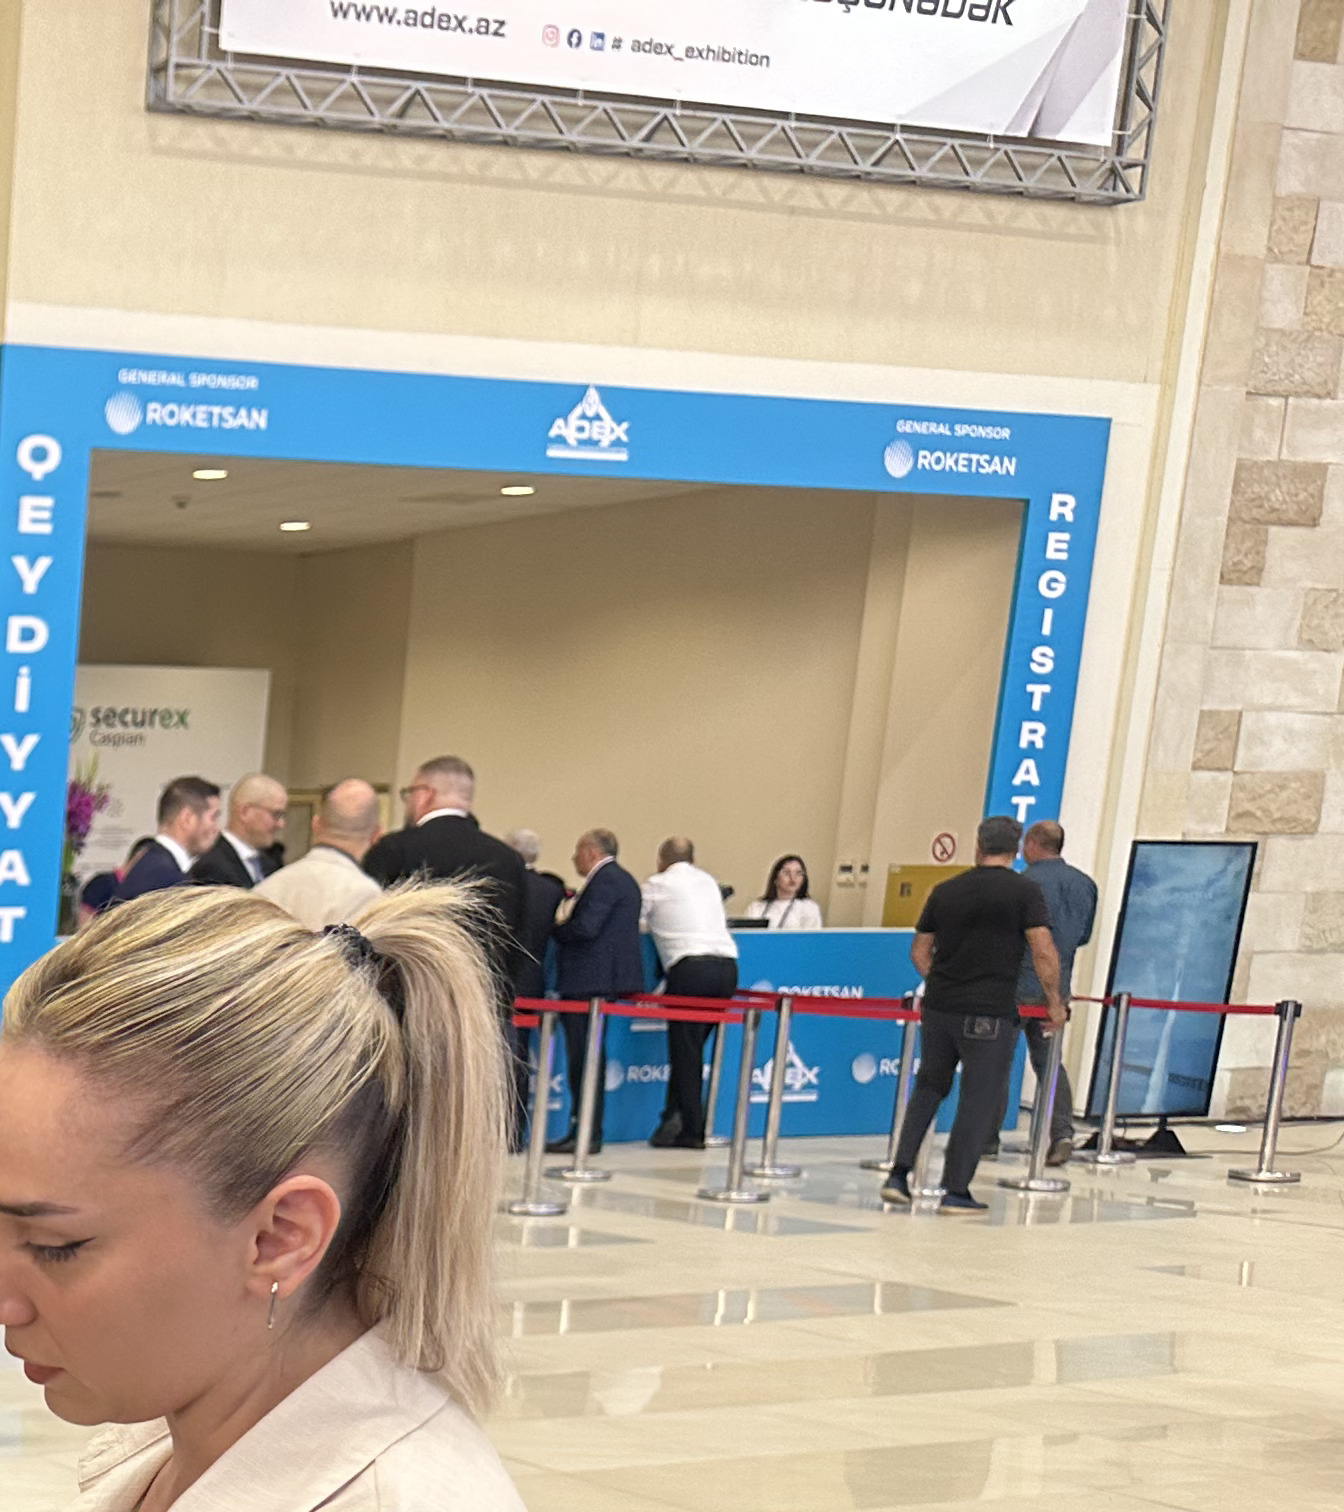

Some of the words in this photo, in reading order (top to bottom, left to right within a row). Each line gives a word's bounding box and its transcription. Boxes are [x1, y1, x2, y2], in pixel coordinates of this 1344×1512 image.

[330, 0, 507, 38] www.adex.az
[631, 38, 770, 68] adex_exhibition
[118, 368, 186, 387] GENERAL
[188, 372, 259, 390] SPONSOR
[145, 402, 268, 431] ROKETSAN
[896, 419, 952, 436] GENERAL
[953, 423, 1011, 440] SPONSOR
[917, 449, 1016, 476] ROKETSAN
[1011, 493, 1076, 823] REGISTRAT
[89, 705, 190, 730] securex
[89, 730, 146, 748] Caspian
